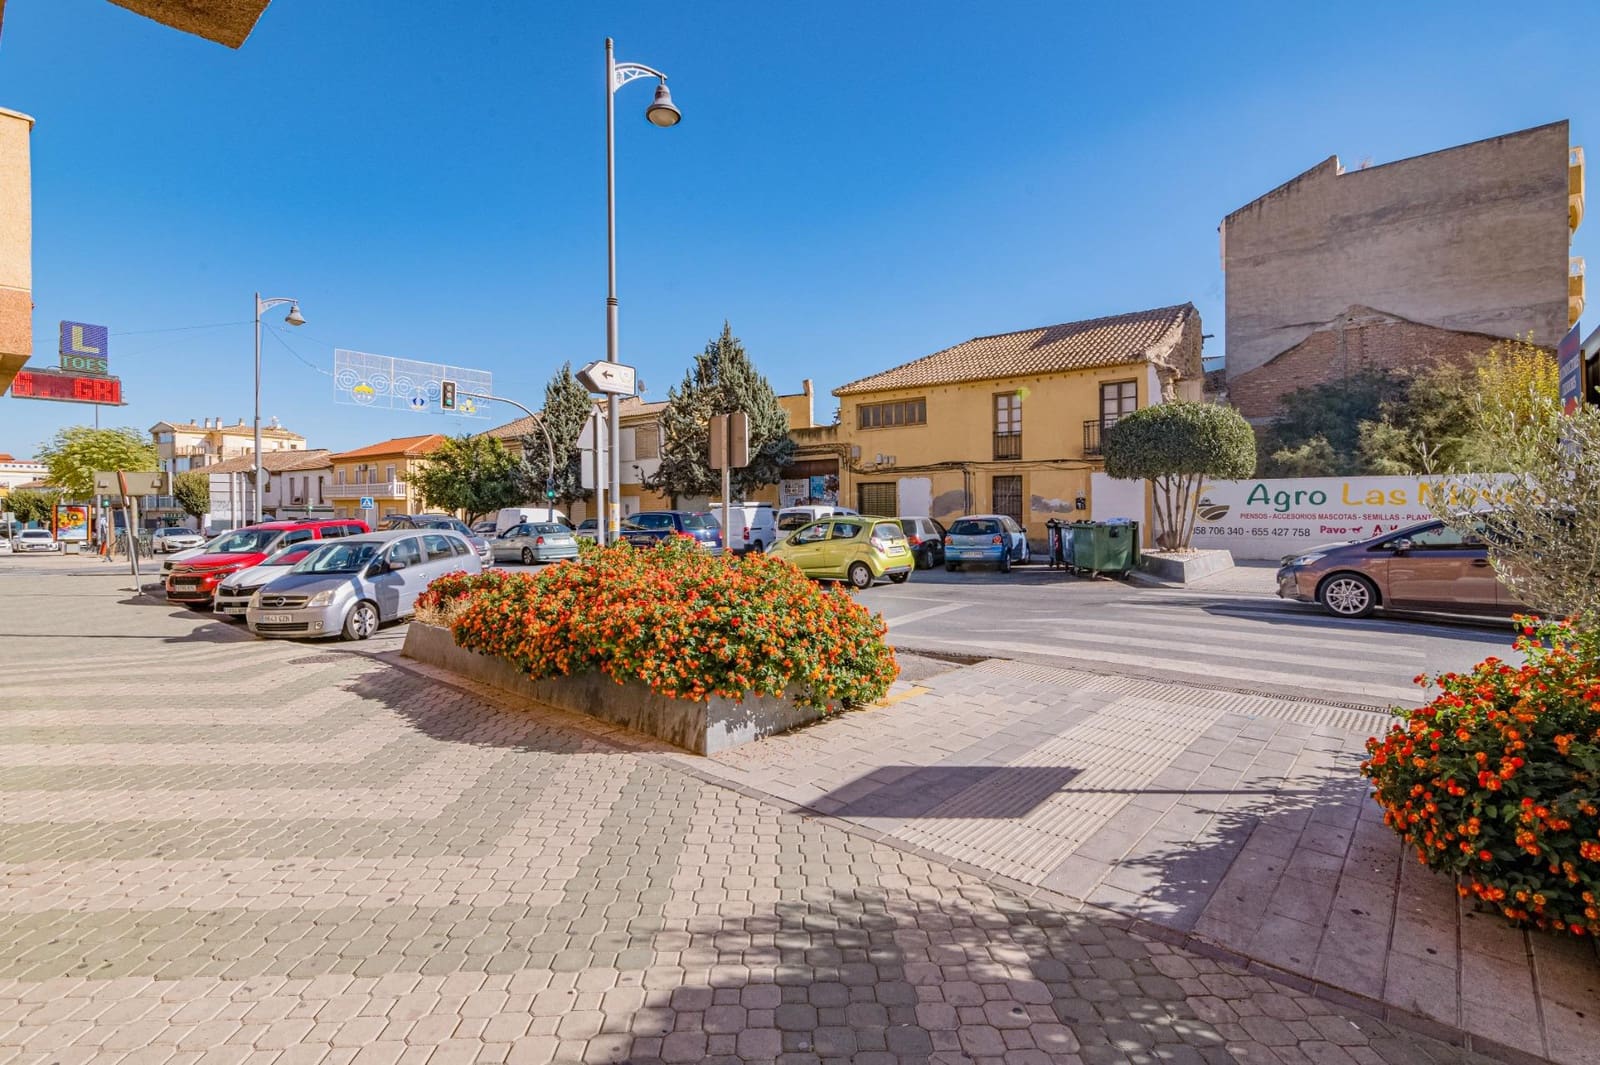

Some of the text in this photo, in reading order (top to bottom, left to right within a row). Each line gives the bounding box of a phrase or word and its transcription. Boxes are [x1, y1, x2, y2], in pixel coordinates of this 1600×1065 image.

[1246, 483, 1328, 513] Agro
[1341, 482, 1408, 507] Las
[1208, 526, 1225, 536] 706
[1227, 526, 1244, 536] 340
[1251, 527, 1270, 537] 655
[1271, 528, 1290, 537] 427
[1292, 528, 1310, 537] 758
[1320, 525, 1347, 534] Pavo
